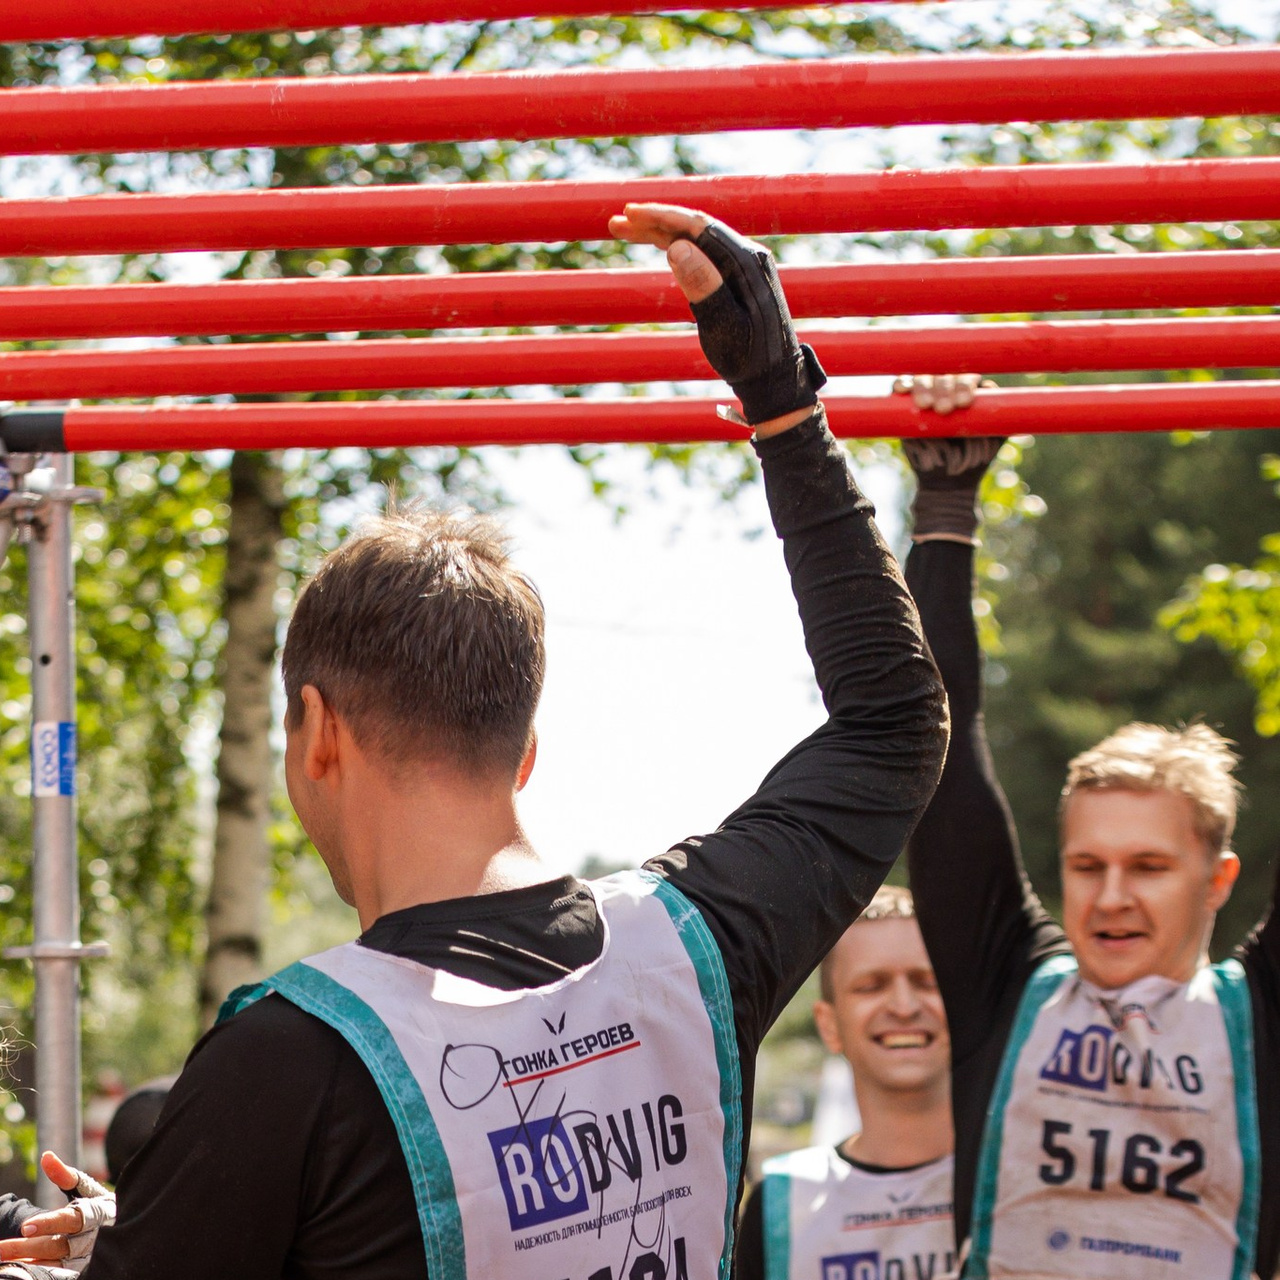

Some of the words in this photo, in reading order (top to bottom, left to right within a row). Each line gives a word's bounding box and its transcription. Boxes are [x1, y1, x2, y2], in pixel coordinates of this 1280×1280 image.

[502, 1047, 560, 1080] ГОНКА
[560, 1022, 635, 1062] ГЕРОЕВ
[501, 1094, 688, 1216] RODVIG
[1038, 1119, 1206, 1205] 5162
[514, 1230, 561, 1251] НАДЕЖНОСТЬ
